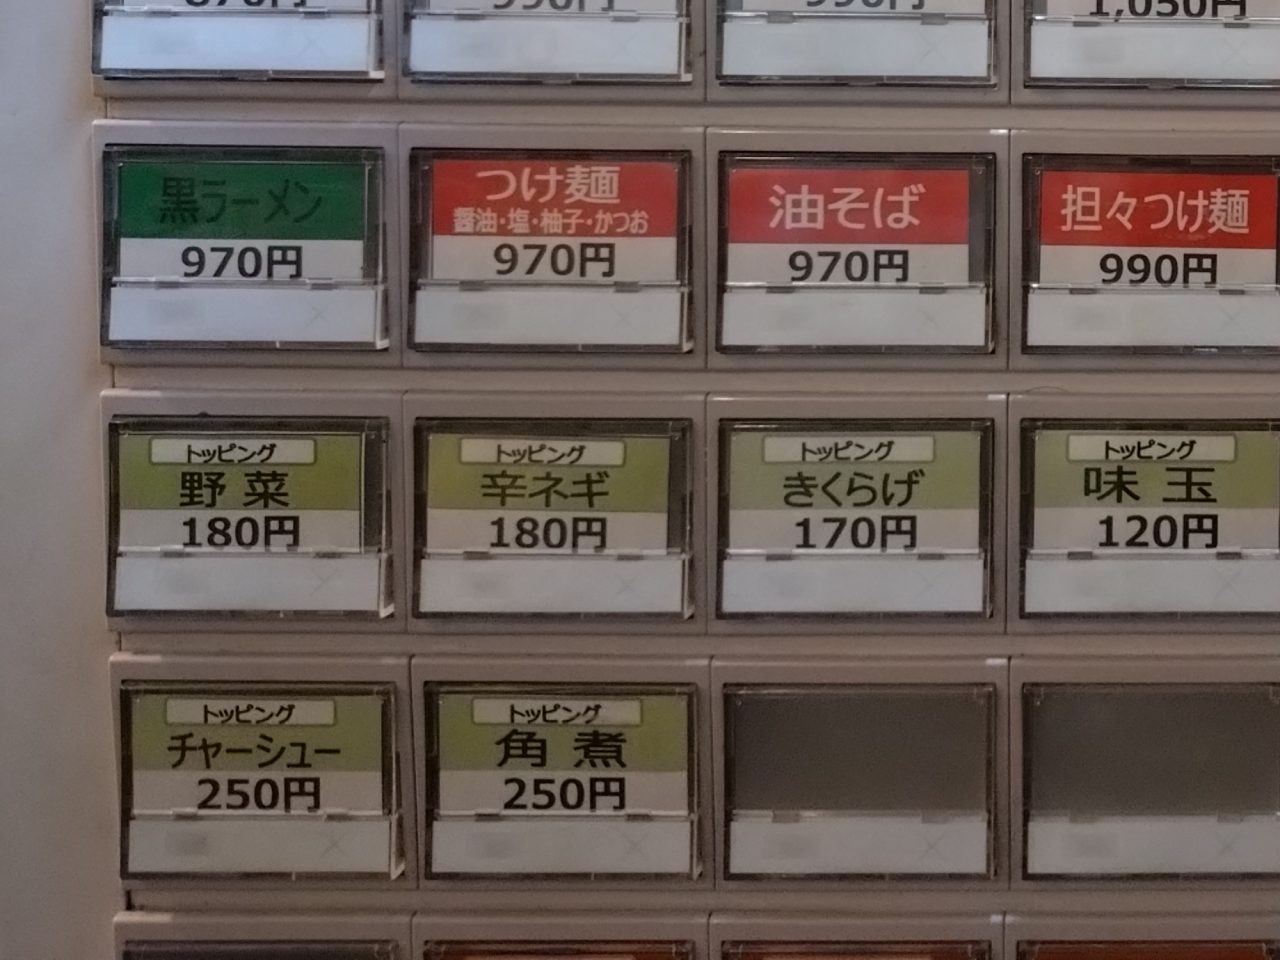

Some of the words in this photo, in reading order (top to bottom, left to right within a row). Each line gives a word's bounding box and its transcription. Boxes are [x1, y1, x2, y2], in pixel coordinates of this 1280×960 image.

[160, 176, 322, 224] 黒ラーメン
[476, 164, 621, 204] つけ麺
[768, 184, 926, 230] 油そば
[1060, 184, 1250, 235] 担々つけ麺
[181, 245, 303, 279] 970円
[493, 242, 616, 278] 970円
[788, 250, 909, 284] 970円
[1099, 253, 1218, 288] 990円
[186, 444, 276, 464] トッピング
[496, 444, 586, 465] トッピング
[800, 441, 894, 462] トッピング
[1104, 440, 1197, 461] トッピング
[180, 471, 289, 508] 野菜
[481, 471, 610, 509] 辛ネギ
[783, 469, 925, 508] きくらげ
[1084, 466, 1217, 504] 味玉
[182, 515, 300, 549] 180円
[490, 516, 607, 551] 180円
[795, 515, 918, 551] 170円
[1098, 514, 1219, 549] 120円
[202, 704, 295, 725] トッピング
[510, 704, 602, 725] トッピング
[167, 732, 341, 770] チャーシュー
[495, 729, 627, 769] 角煮
[197, 777, 321, 811] 250円
[503, 777, 627, 811] 250円
